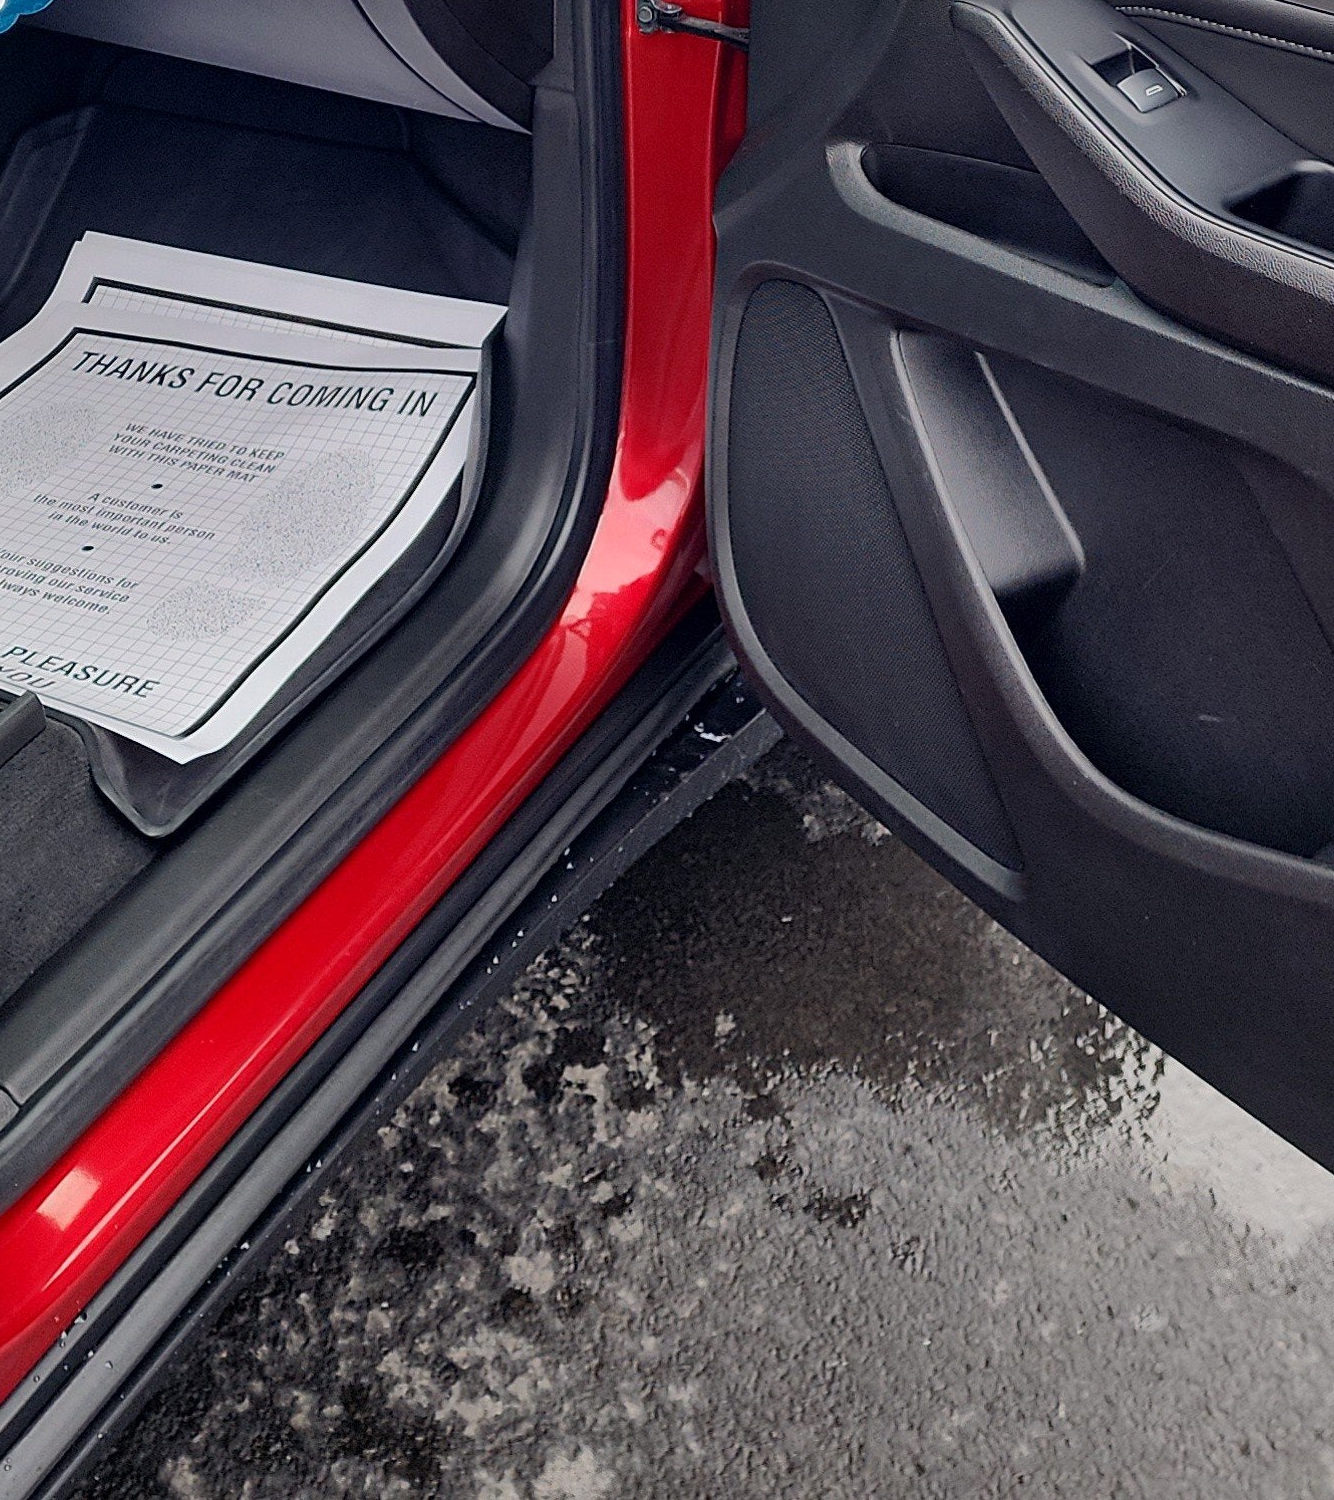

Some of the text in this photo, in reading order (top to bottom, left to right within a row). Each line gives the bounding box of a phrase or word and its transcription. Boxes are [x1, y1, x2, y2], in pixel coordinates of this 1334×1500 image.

[71, 351, 440, 417] THANKS FOR COMING IN
[113, 433, 277, 474] YOUR CARPETING CLEAN
[125, 423, 285, 461] WE HAVE TRIED TO KEEP
[108, 444, 259, 483] WITH THIS PAPER MAT
[33, 493, 216, 541] the most important person
[88, 493, 184, 520] A customer is
[48, 511, 171, 545] in the world to us.
[26, 556, 115, 585] suggestions
[115, 577, 140, 590] for
[47, 578, 75, 591] our
[75, 585, 131, 603] service
[41, 591, 111, 615] welcome.
[1, 646, 161, 699] PLEASURE
